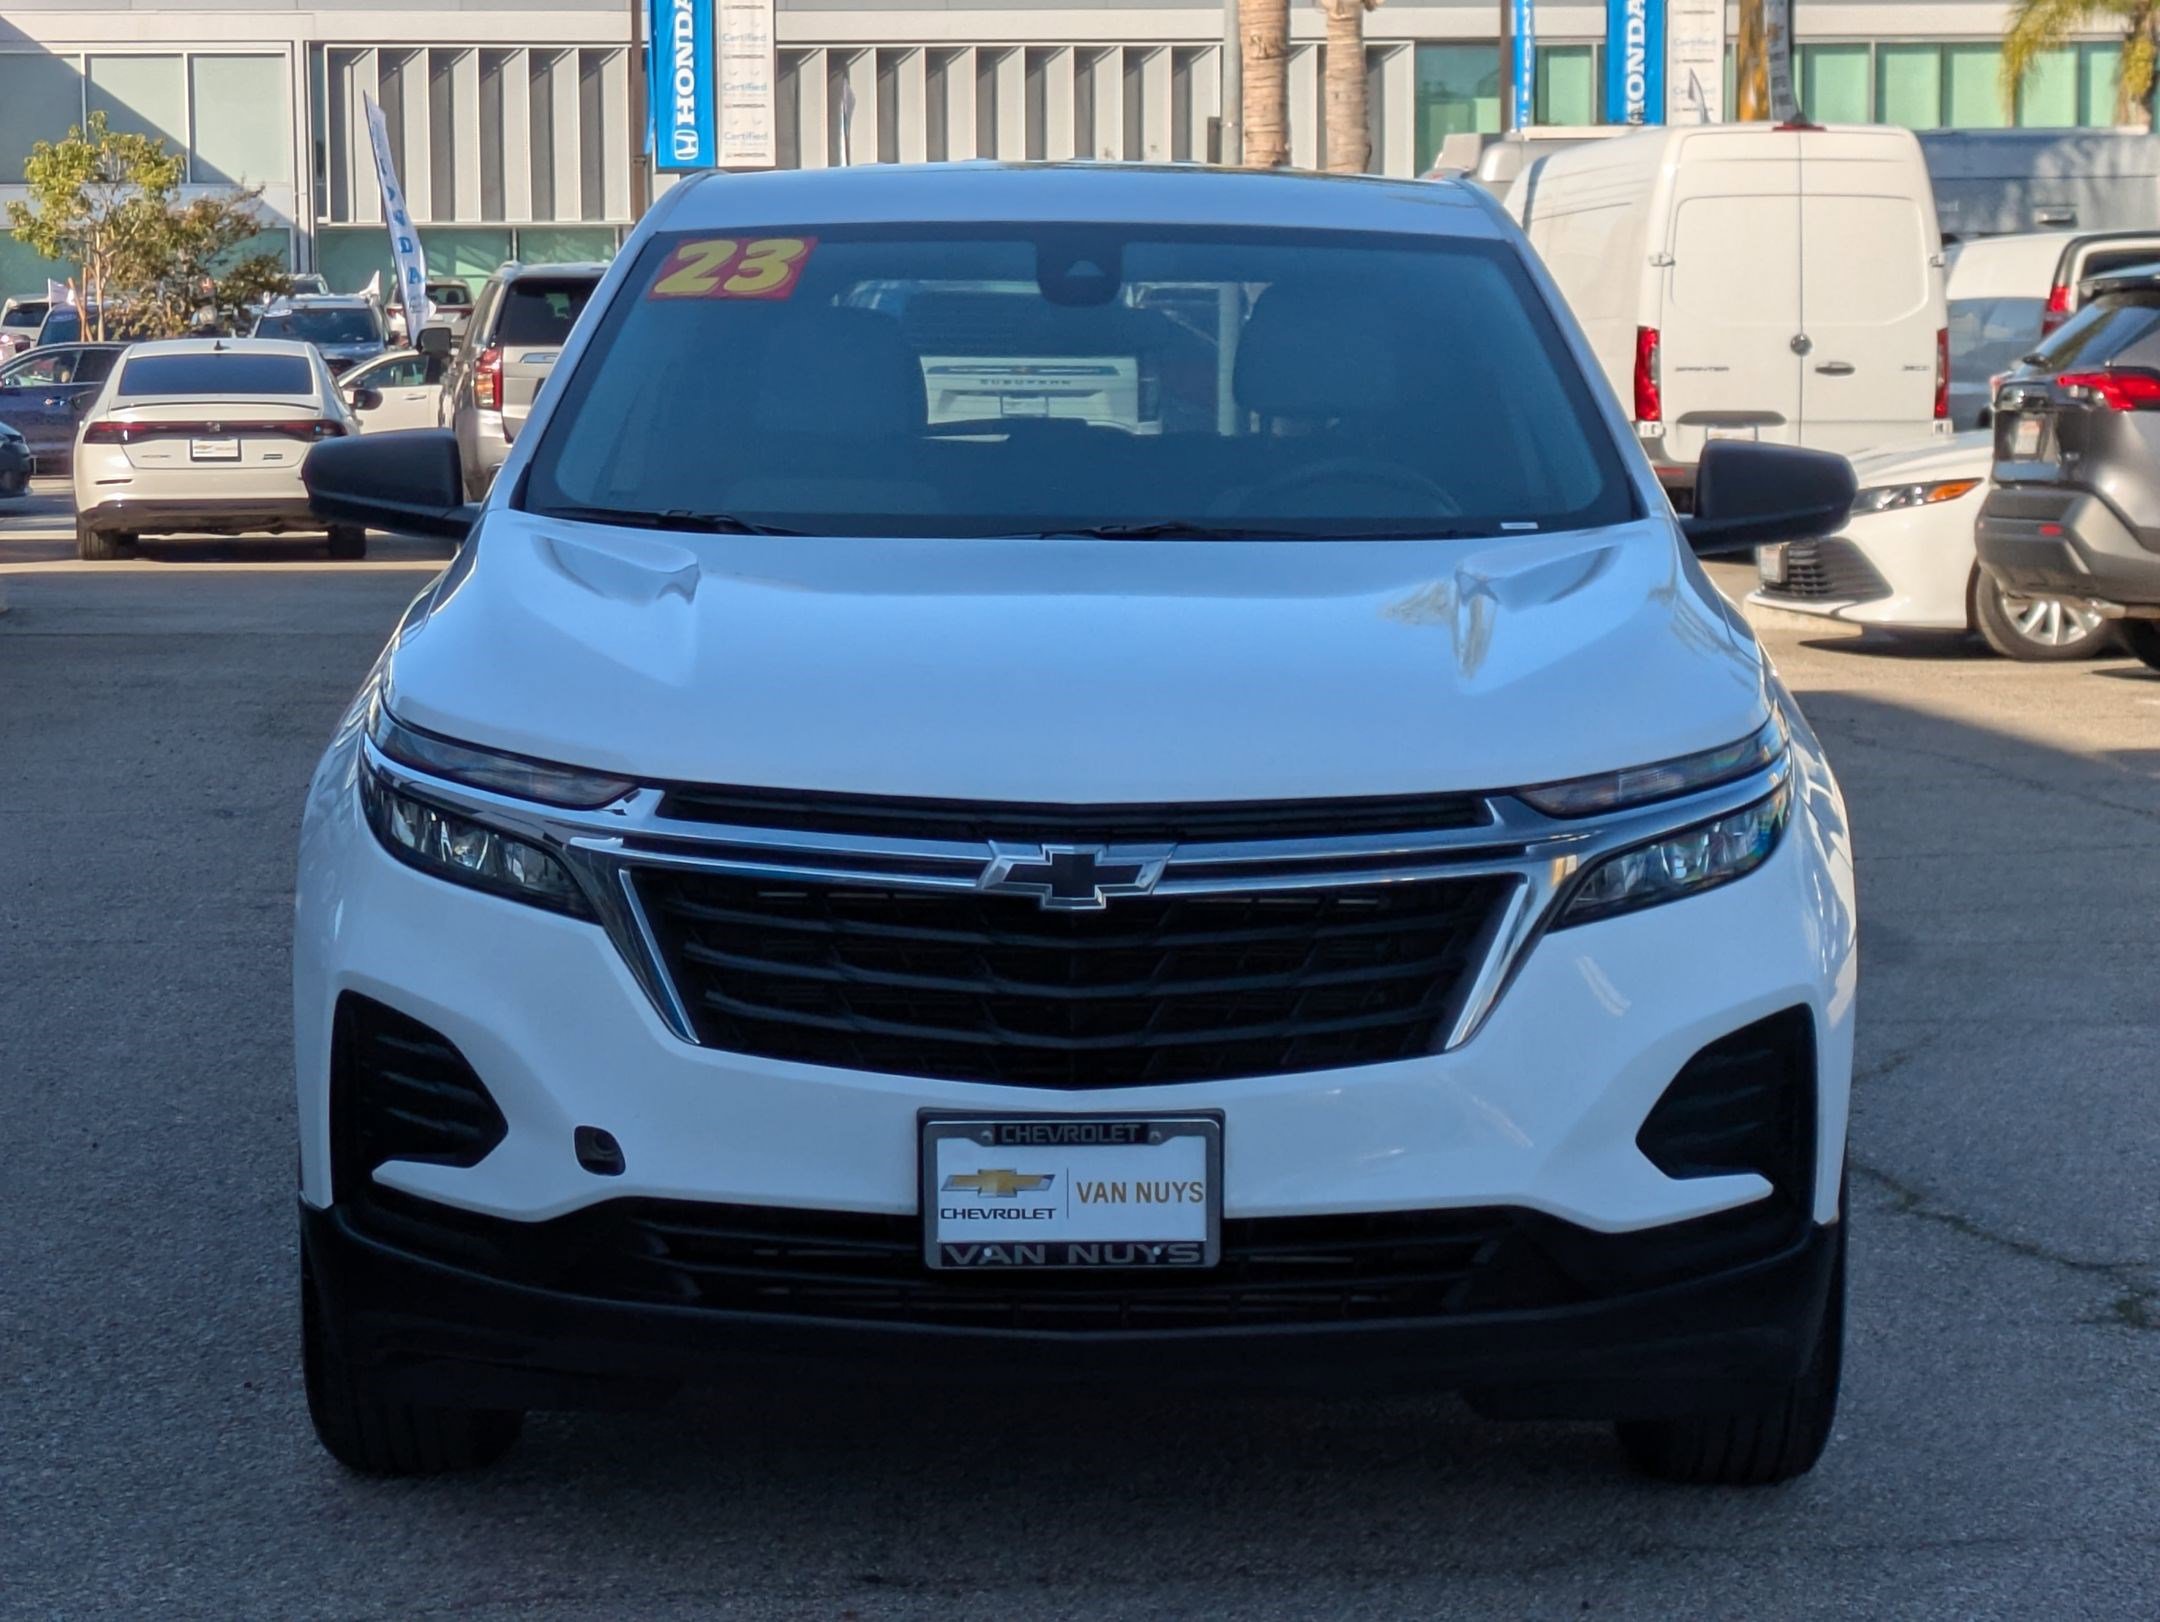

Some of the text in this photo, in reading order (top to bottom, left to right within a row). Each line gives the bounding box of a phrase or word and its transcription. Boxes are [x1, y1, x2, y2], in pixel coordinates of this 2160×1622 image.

[722, 33, 767, 42] Certified
[723, 82, 768, 91] Certified
[724, 131, 768, 141] Certified
[654, 238, 808, 295] 23
[1001, 1123, 1141, 1143] CHEVROLET
[1077, 1181, 1204, 1203] VAN NUYS
[940, 1208, 1056, 1220] CHEVROLET
[945, 1243, 1200, 1265] VAN NUYS
